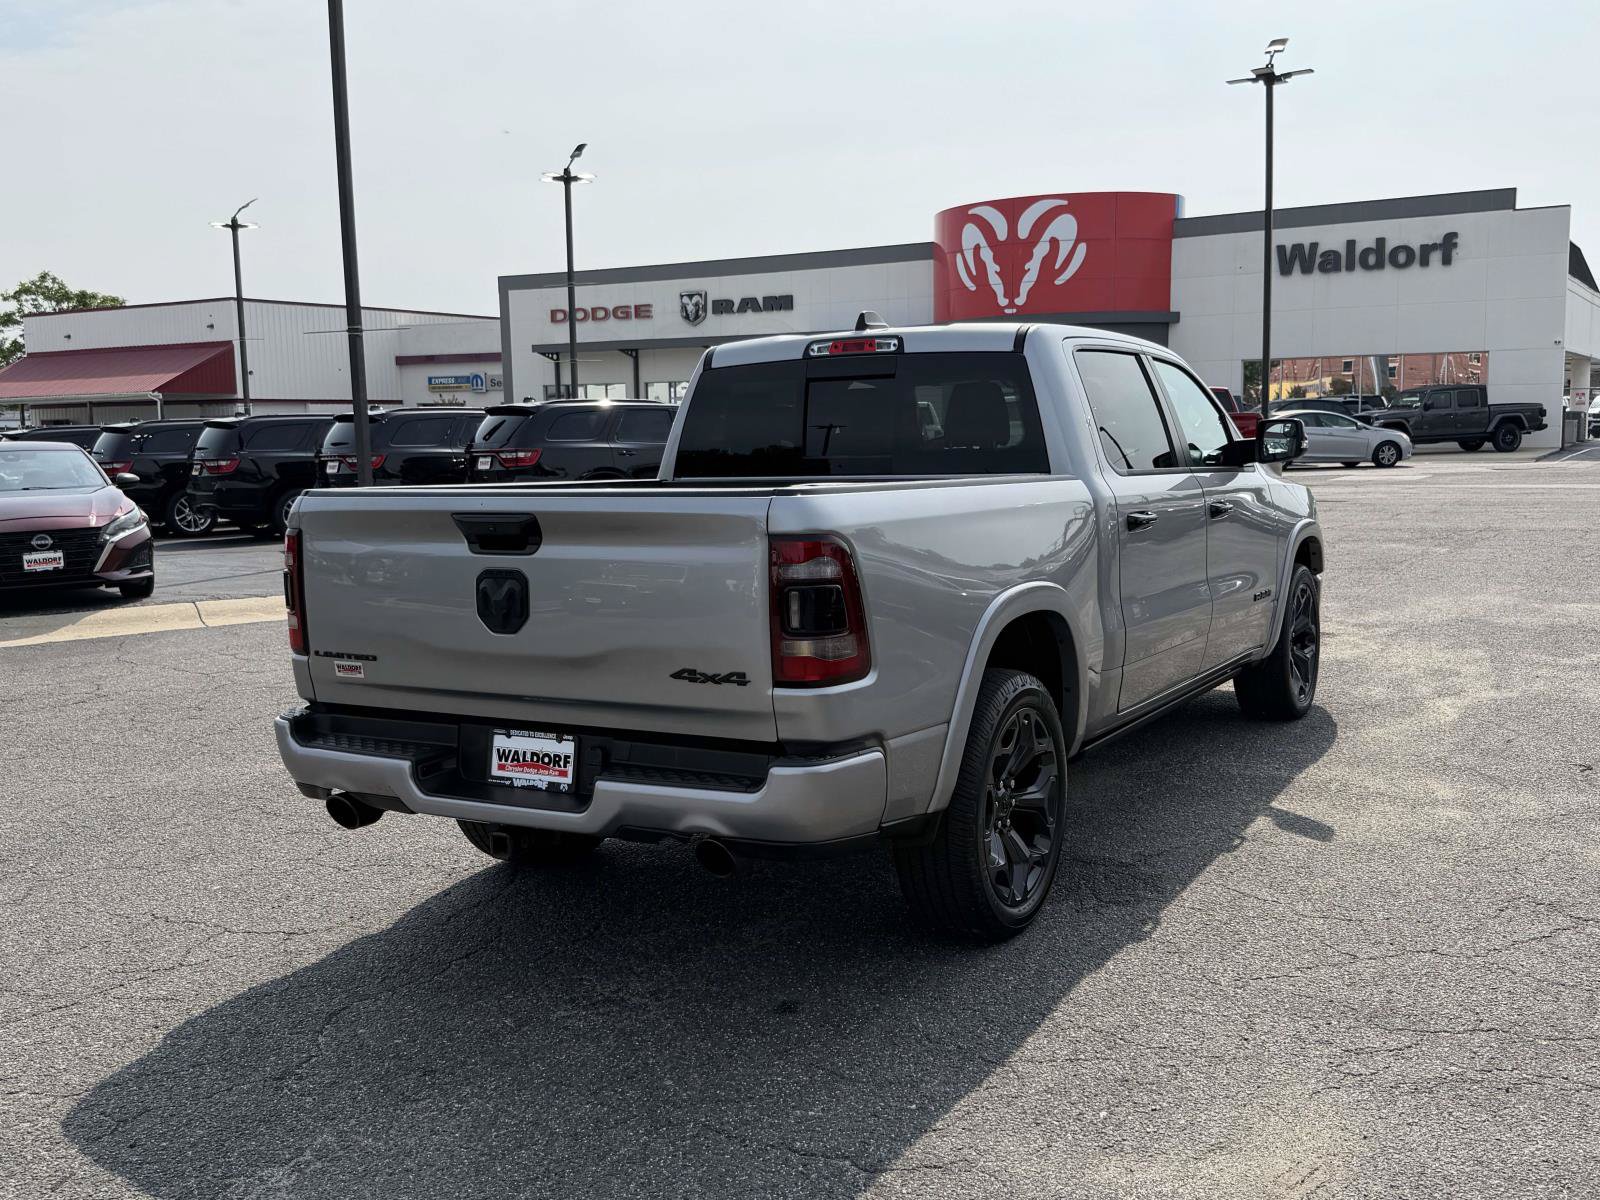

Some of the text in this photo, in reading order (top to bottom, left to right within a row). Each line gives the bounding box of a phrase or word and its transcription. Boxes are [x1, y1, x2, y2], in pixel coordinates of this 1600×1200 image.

[1276, 231, 1459, 276] Waldorf
[550, 303, 653, 324] DODGE
[712, 294, 793, 315] RAM
[26, 556, 62, 564] WALDORF
[314, 650, 377, 661] LIMITED
[669, 668, 751, 687] 4x4
[496, 748, 571, 768] WALDORF
[505, 765, 524, 773] Chrysler
[523, 766, 538, 775] Dodge
